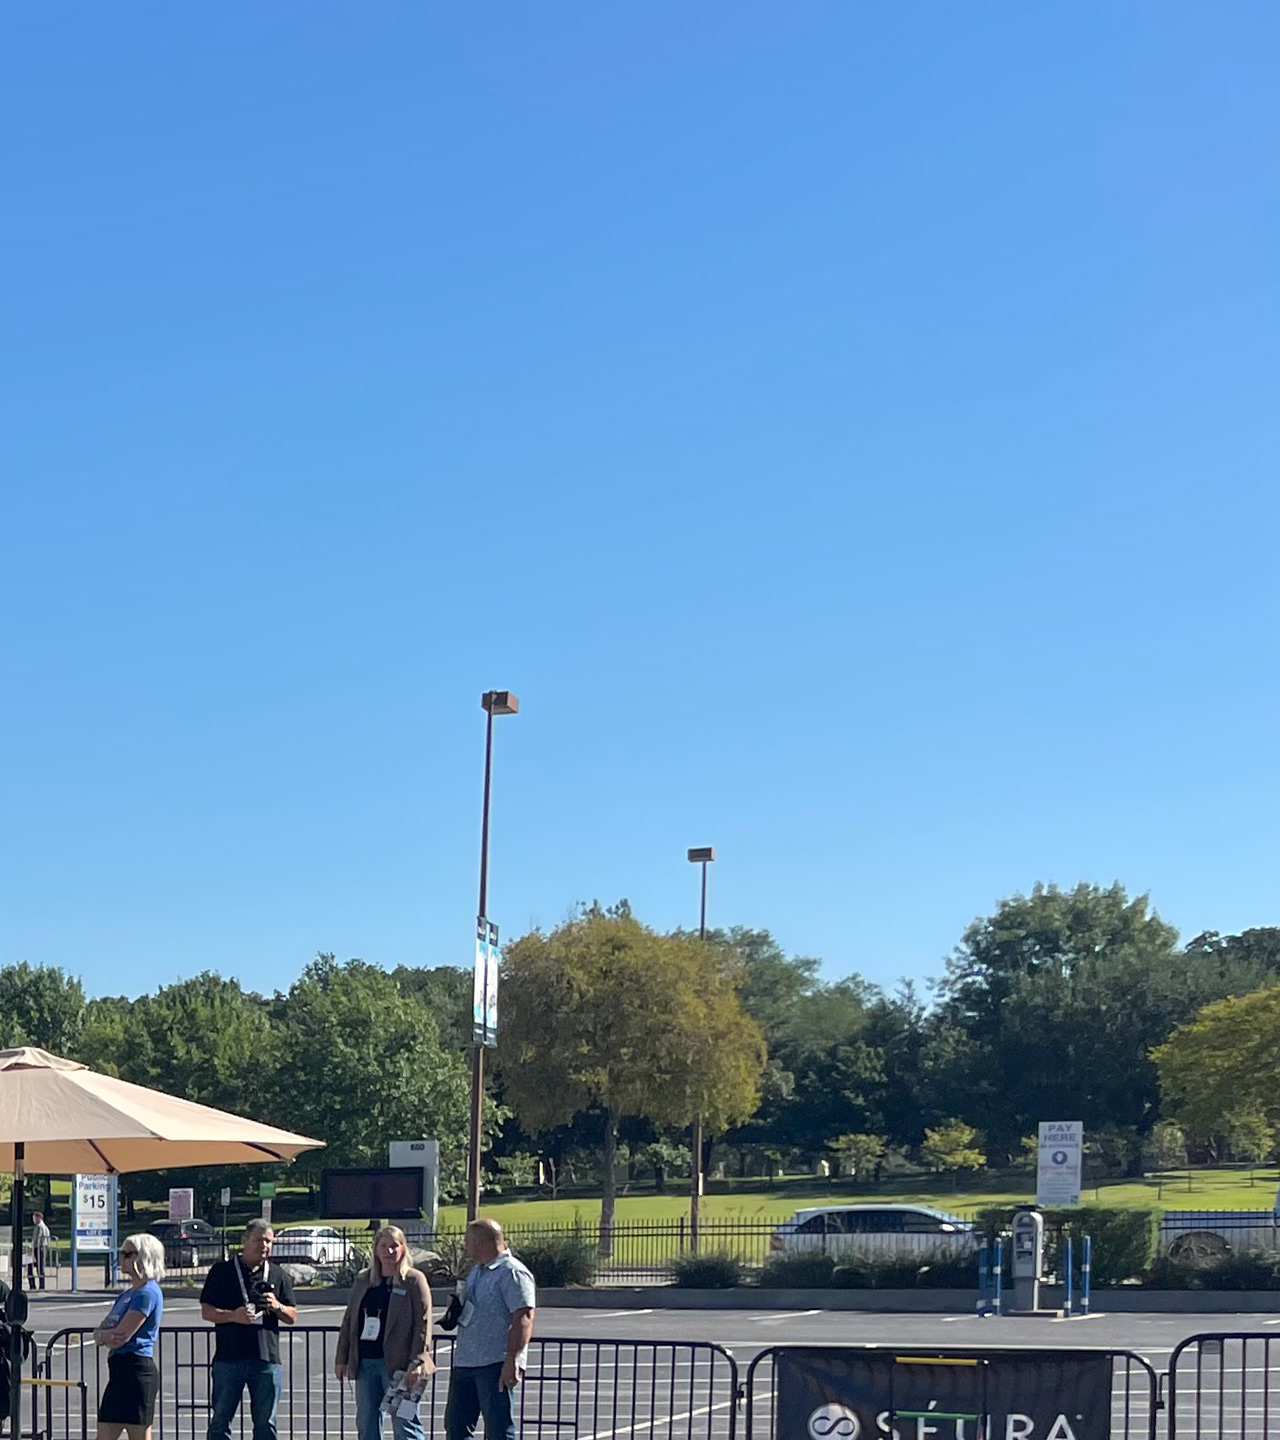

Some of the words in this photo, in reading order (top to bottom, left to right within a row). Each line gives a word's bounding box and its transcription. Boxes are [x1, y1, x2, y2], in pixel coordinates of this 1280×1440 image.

[1047, 1123, 1073, 1132] PAY
[1043, 1133, 1078, 1142] HERE
[78, 1182, 111, 1192] Parking
[83, 1194, 106, 1209] $15
